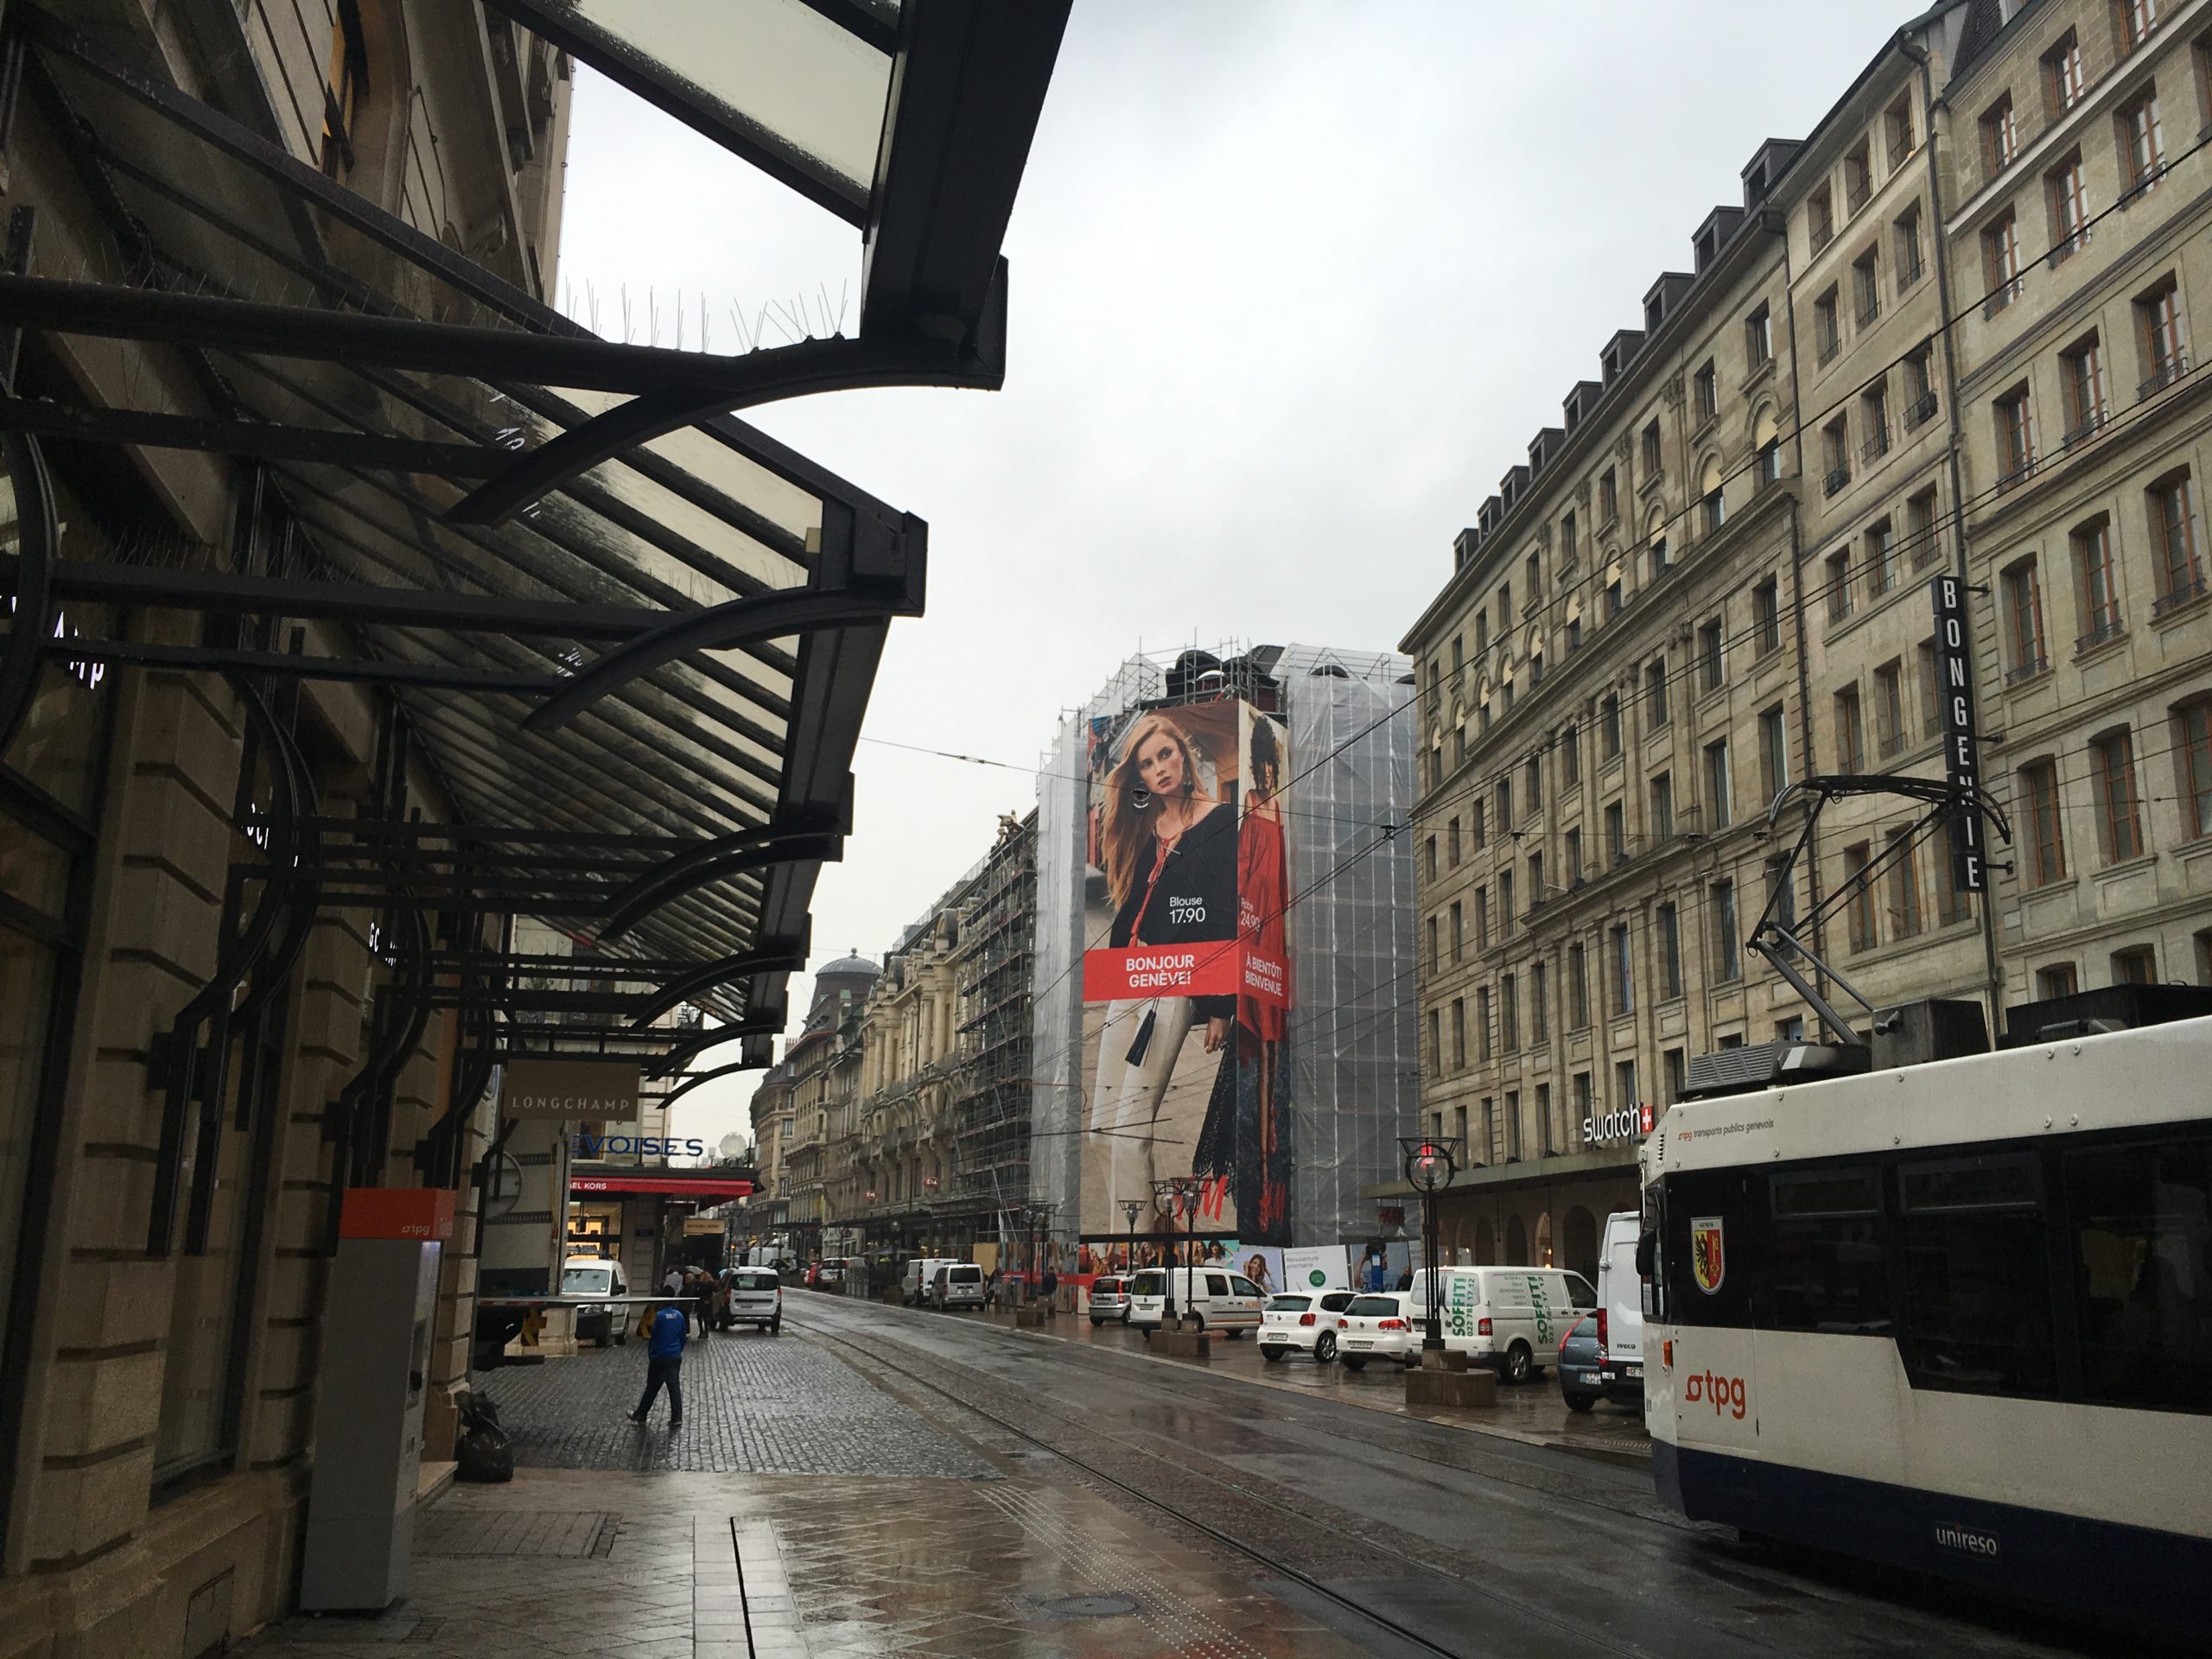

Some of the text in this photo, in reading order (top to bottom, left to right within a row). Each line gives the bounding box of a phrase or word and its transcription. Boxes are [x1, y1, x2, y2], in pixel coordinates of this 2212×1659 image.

[1169, 896, 1203, 907] Blouse
[1169, 906, 1206, 925] 17.90
[1125, 954, 1195, 972] BONJOUR
[1128, 970, 1192, 988] GENÈVE!
[512, 1096, 630, 1111] LONGCHAMP
[1583, 1103, 1641, 1142] swatch
[1694, 1126, 1722, 1138] transports
[1723, 1122, 1745, 1136] publics
[1452, 1278, 1466, 1337] SOFFITI
[1527, 1276, 1548, 1344] SOFFITI
[1936, 1522, 1997, 1555] unireso
